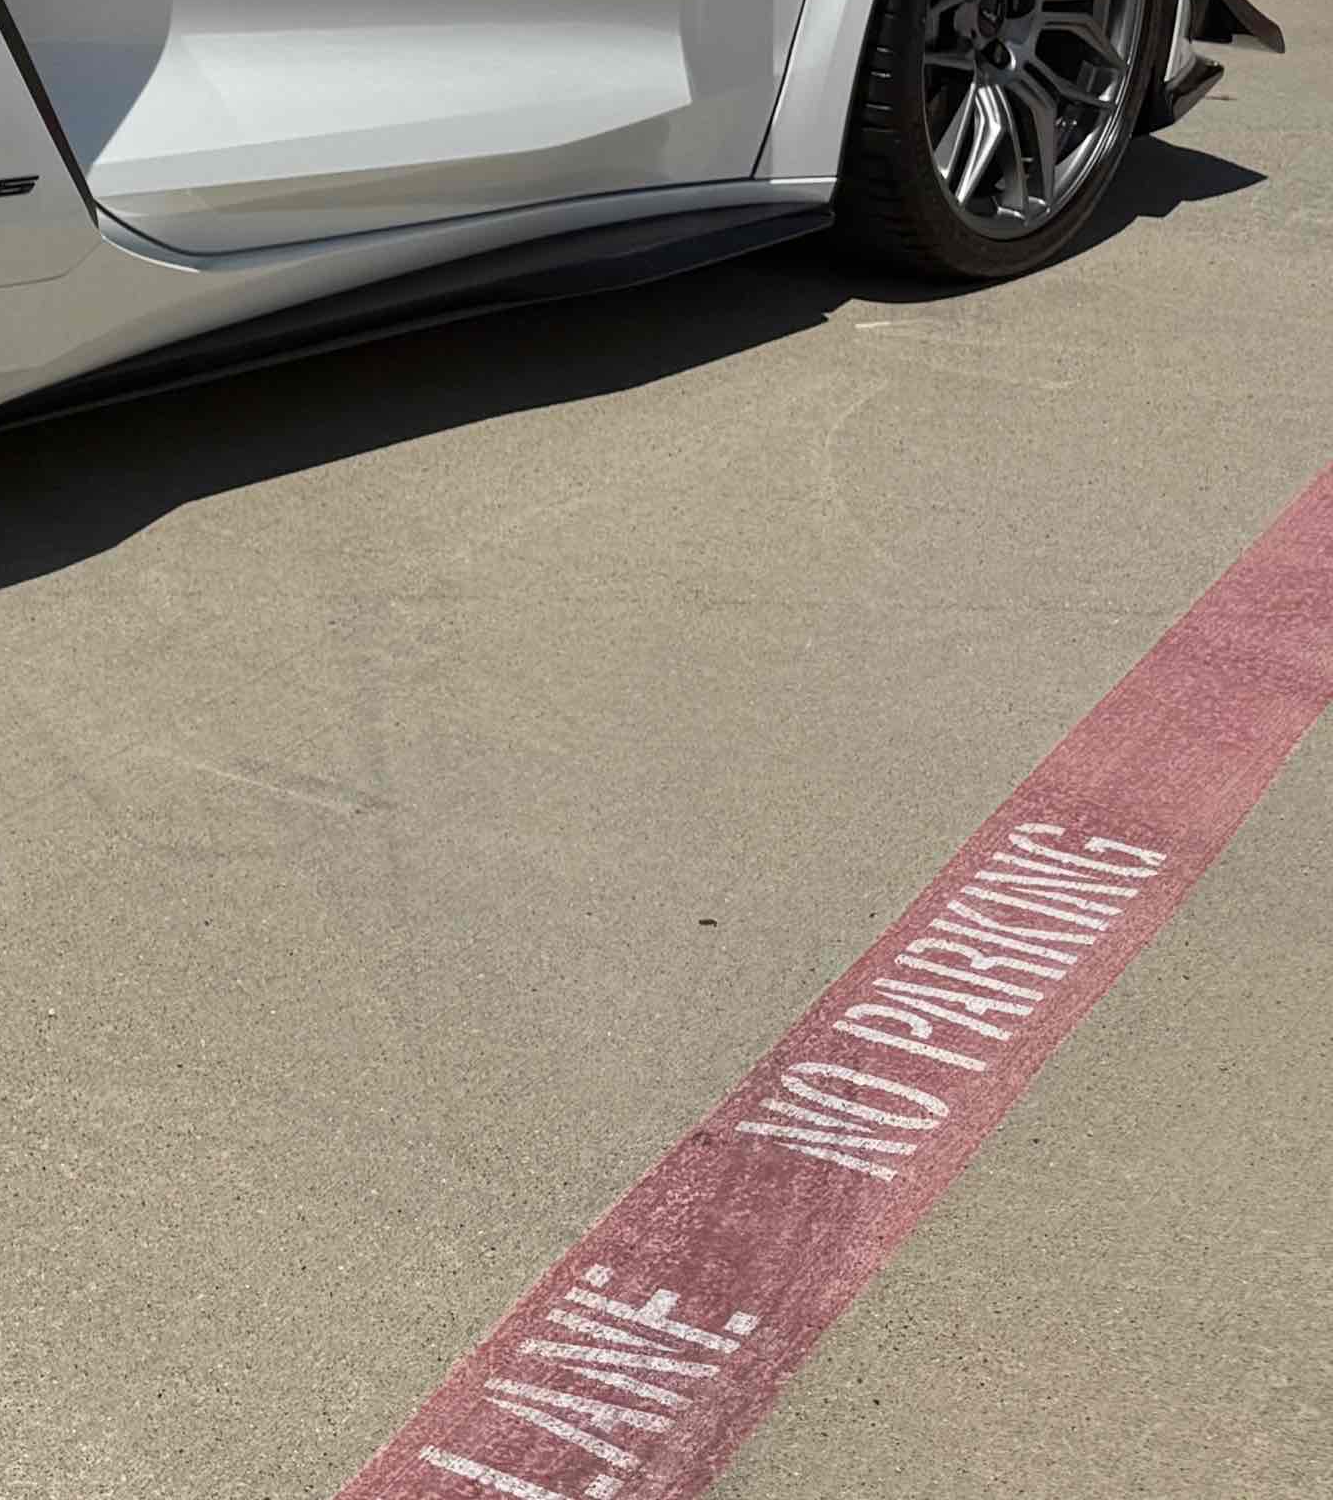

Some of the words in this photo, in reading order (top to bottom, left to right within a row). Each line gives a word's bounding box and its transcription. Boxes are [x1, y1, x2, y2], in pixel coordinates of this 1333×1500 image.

[832, 822, 1167, 1072] PARKING
[735, 1062, 950, 1182] NO
[418, 1263, 758, 1500] LANE
